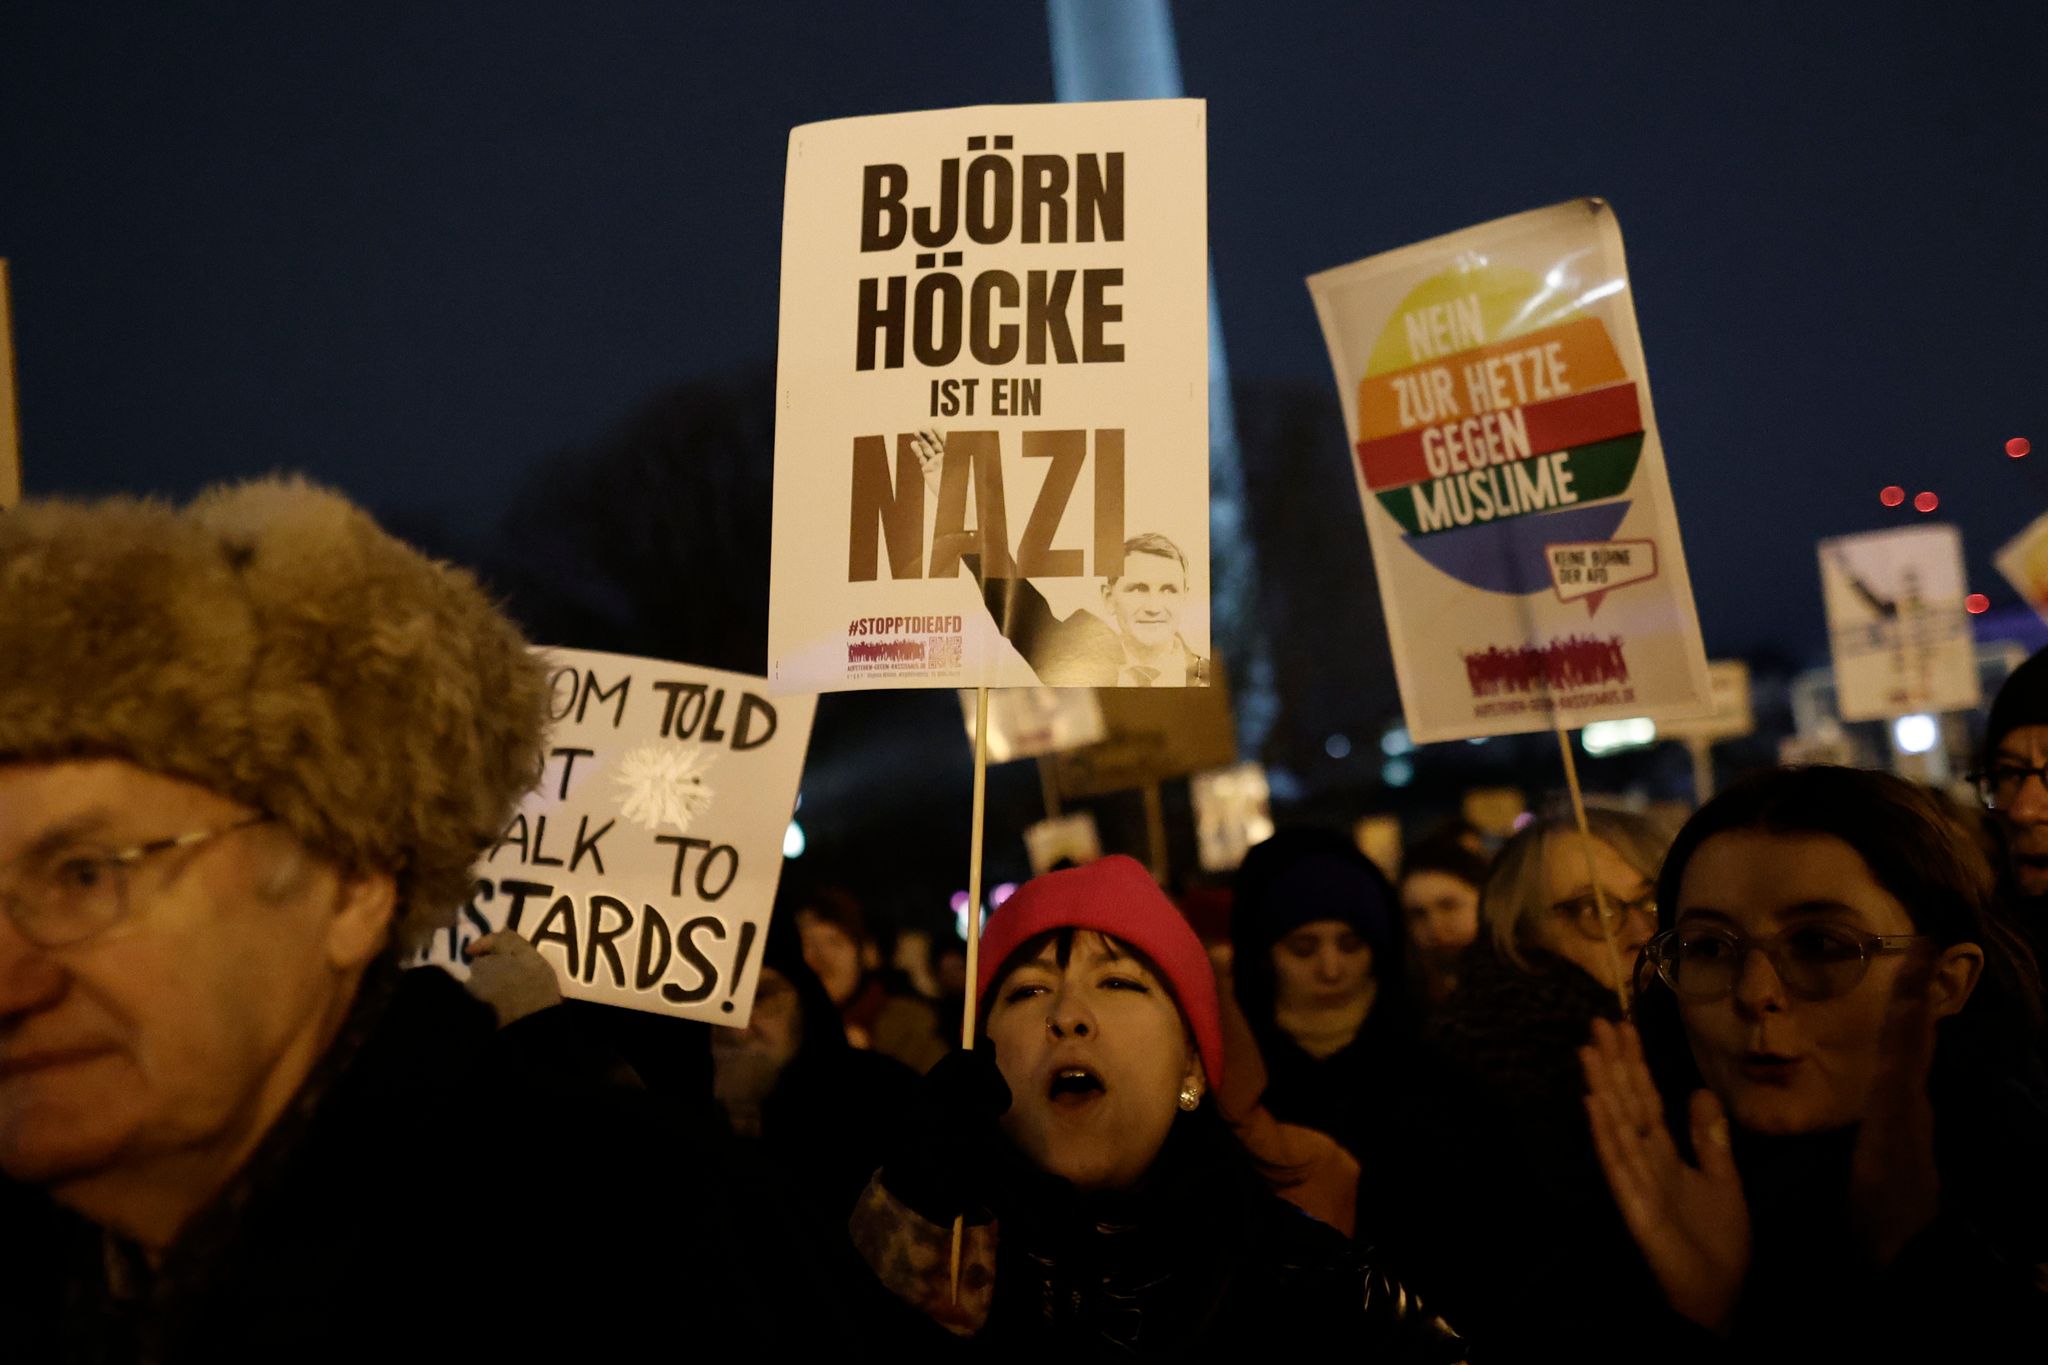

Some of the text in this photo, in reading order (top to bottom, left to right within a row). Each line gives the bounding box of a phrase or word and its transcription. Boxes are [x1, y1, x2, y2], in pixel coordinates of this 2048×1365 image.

[861, 135, 1125, 253] BJÖRN
[856, 251, 1125, 371] HÖCKE
[1405, 292, 1486, 361] NEIN
[930, 378, 1041, 417] IST EIN
[1393, 342, 1572, 430] ZUR HETZE
[1421, 408, 1531, 480] GEGEN
[848, 428, 1125, 582] NAZI
[1411, 452, 1578, 534] MUSLIME
[848, 615, 962, 636] #STOPPTDIEAFD
[548, 667, 778, 752] OM TOLD
[551, 748, 594, 800] T
[488, 813, 739, 902] ALK TO
[421, 878, 757, 1014] STARDS!
